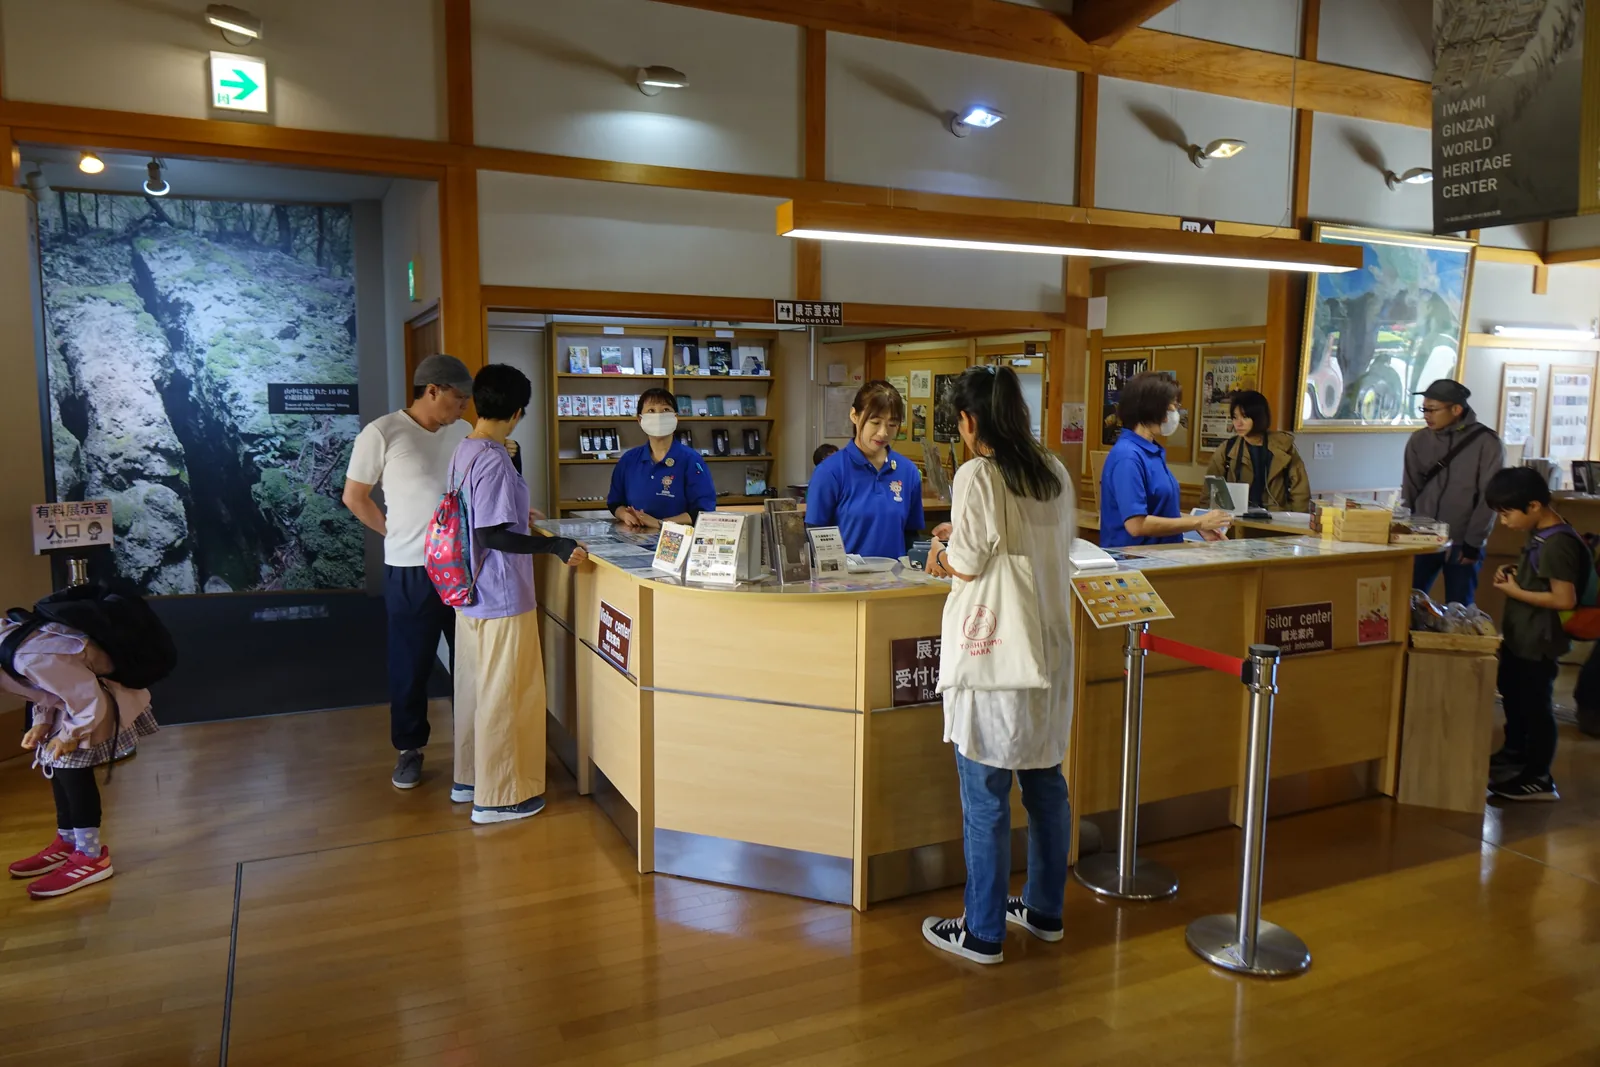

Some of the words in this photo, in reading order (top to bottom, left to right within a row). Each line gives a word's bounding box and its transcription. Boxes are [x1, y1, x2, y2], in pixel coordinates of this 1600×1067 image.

[1442, 95, 1486, 117] IWAMI
[1442, 114, 1495, 137] GINZAN
[1442, 136, 1493, 158] WORLD
[1442, 153, 1512, 179] HERITAGE
[1442, 178, 1498, 199] CENTER
[795, 303, 840, 317] 展示室受付
[36, 502, 108, 518] 有料展示室
[46, 524, 80, 541] 入口
[1300, 609, 1332, 626] center
[1281, 627, 1314, 641] 観光案内
[970, 647, 991, 657] NARA
